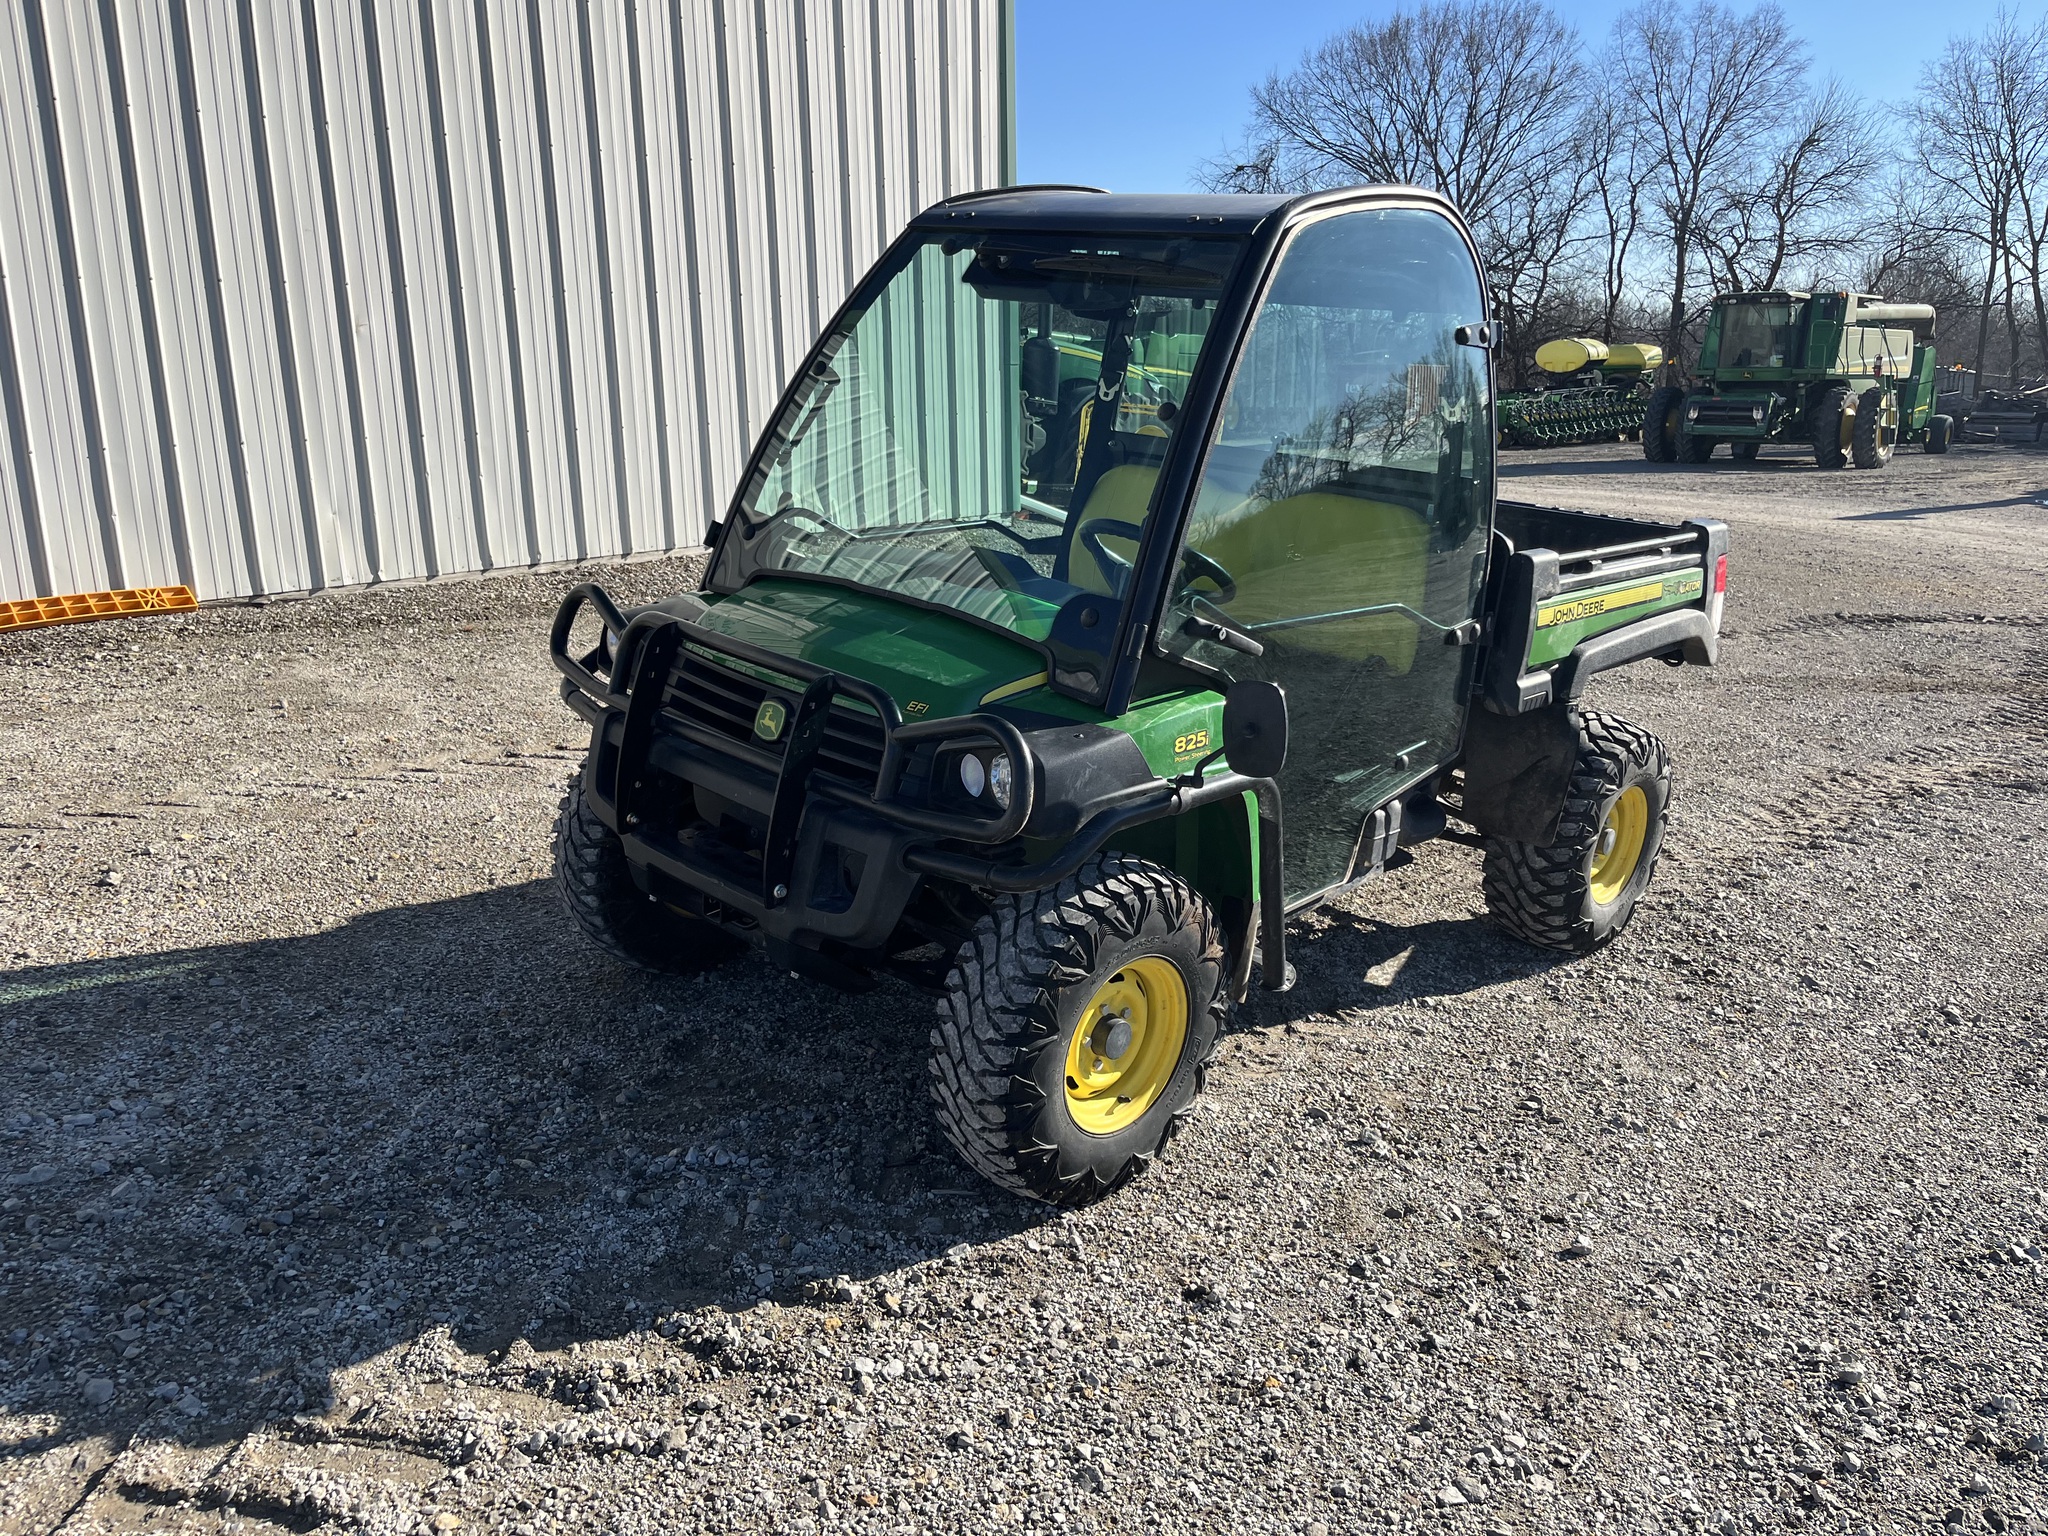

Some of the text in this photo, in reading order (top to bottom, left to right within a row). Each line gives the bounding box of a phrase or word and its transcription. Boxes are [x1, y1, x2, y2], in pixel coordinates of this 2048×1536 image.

[1550, 599, 1605, 624] JOHN DEERE
[906, 701, 930, 714] EFI
[1174, 731, 1209, 753] 825i
